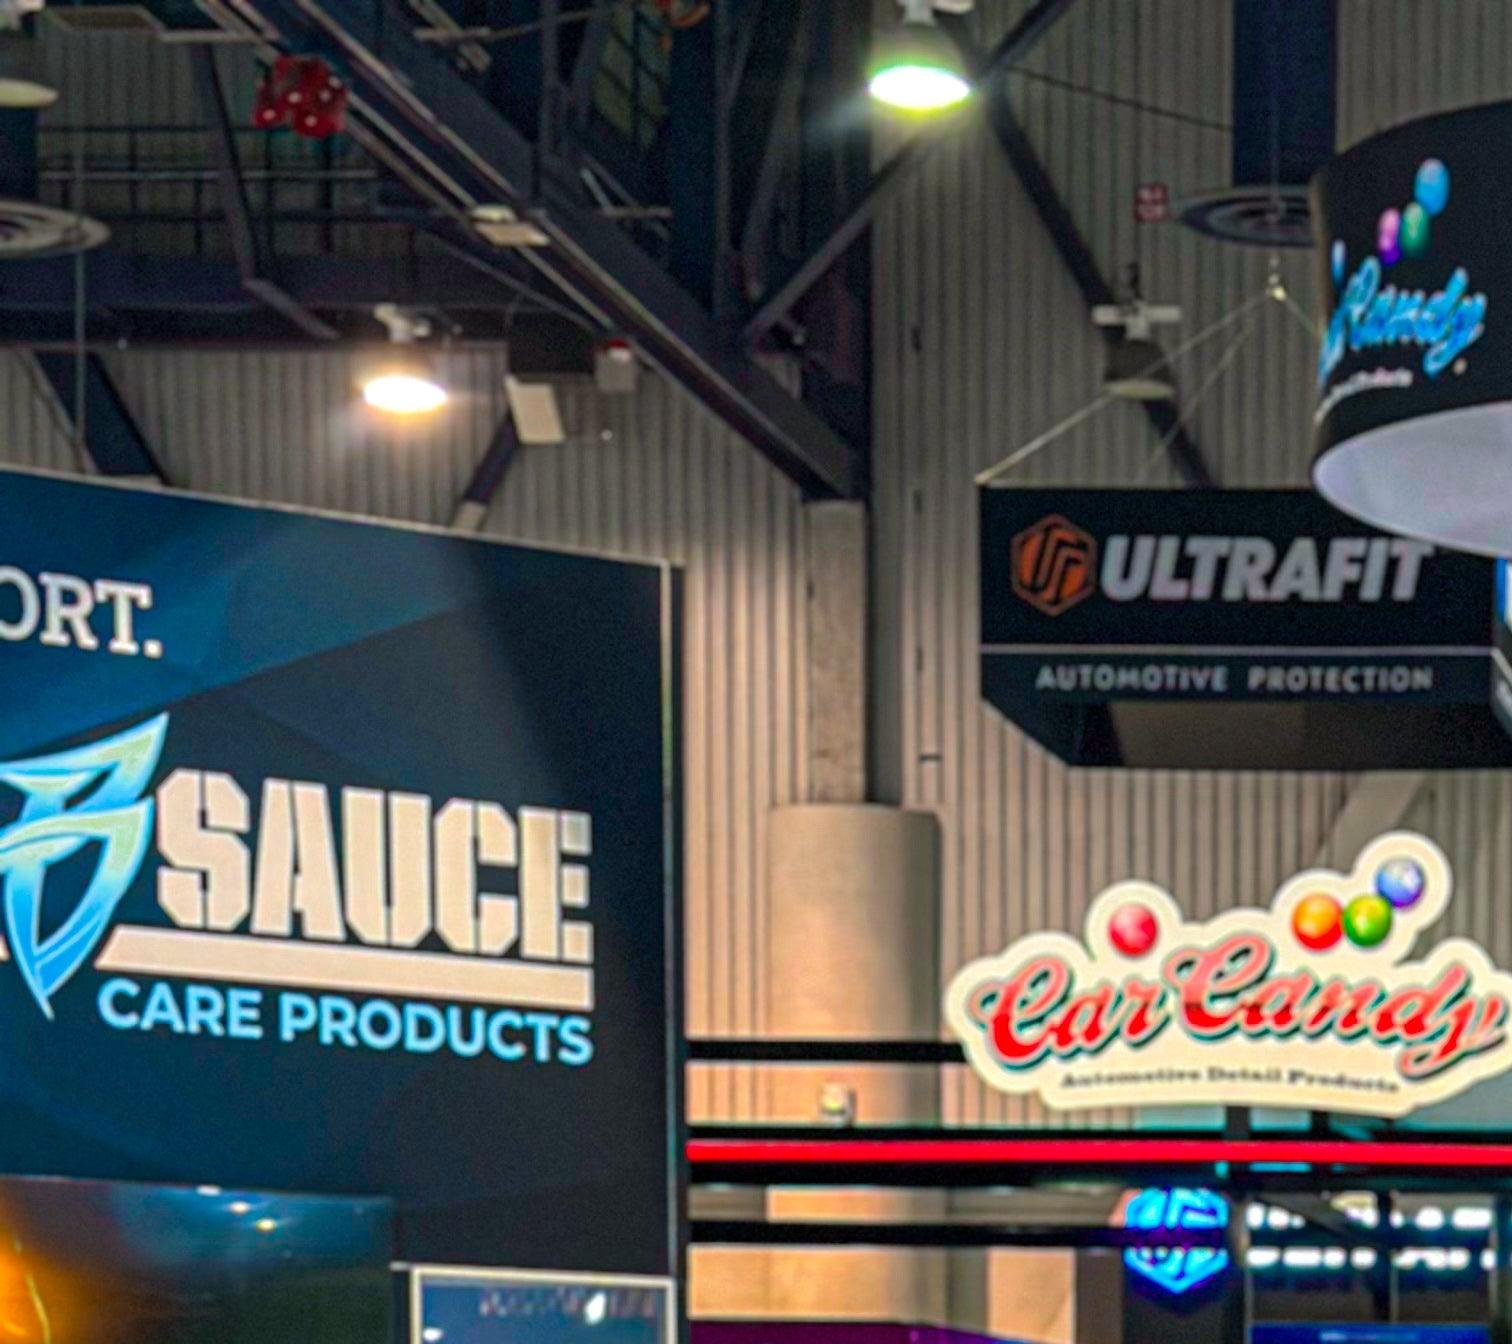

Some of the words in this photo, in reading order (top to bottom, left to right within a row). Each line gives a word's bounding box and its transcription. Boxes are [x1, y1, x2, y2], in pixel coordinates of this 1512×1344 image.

[1101, 535, 1434, 600] ULTRAFIT
[1035, 665, 1229, 692] AUTOMOTIVE
[1248, 665, 1433, 692] PROTECTION
[156, 768, 593, 963] SAUCE
[98, 978, 264, 1040] CARE
[280, 992, 594, 1066] PRODUCTS
[968, 956, 1171, 1072] Car
[1162, 934, 1509, 1077] Candy
[1207, 1066, 1283, 1082] Detail
